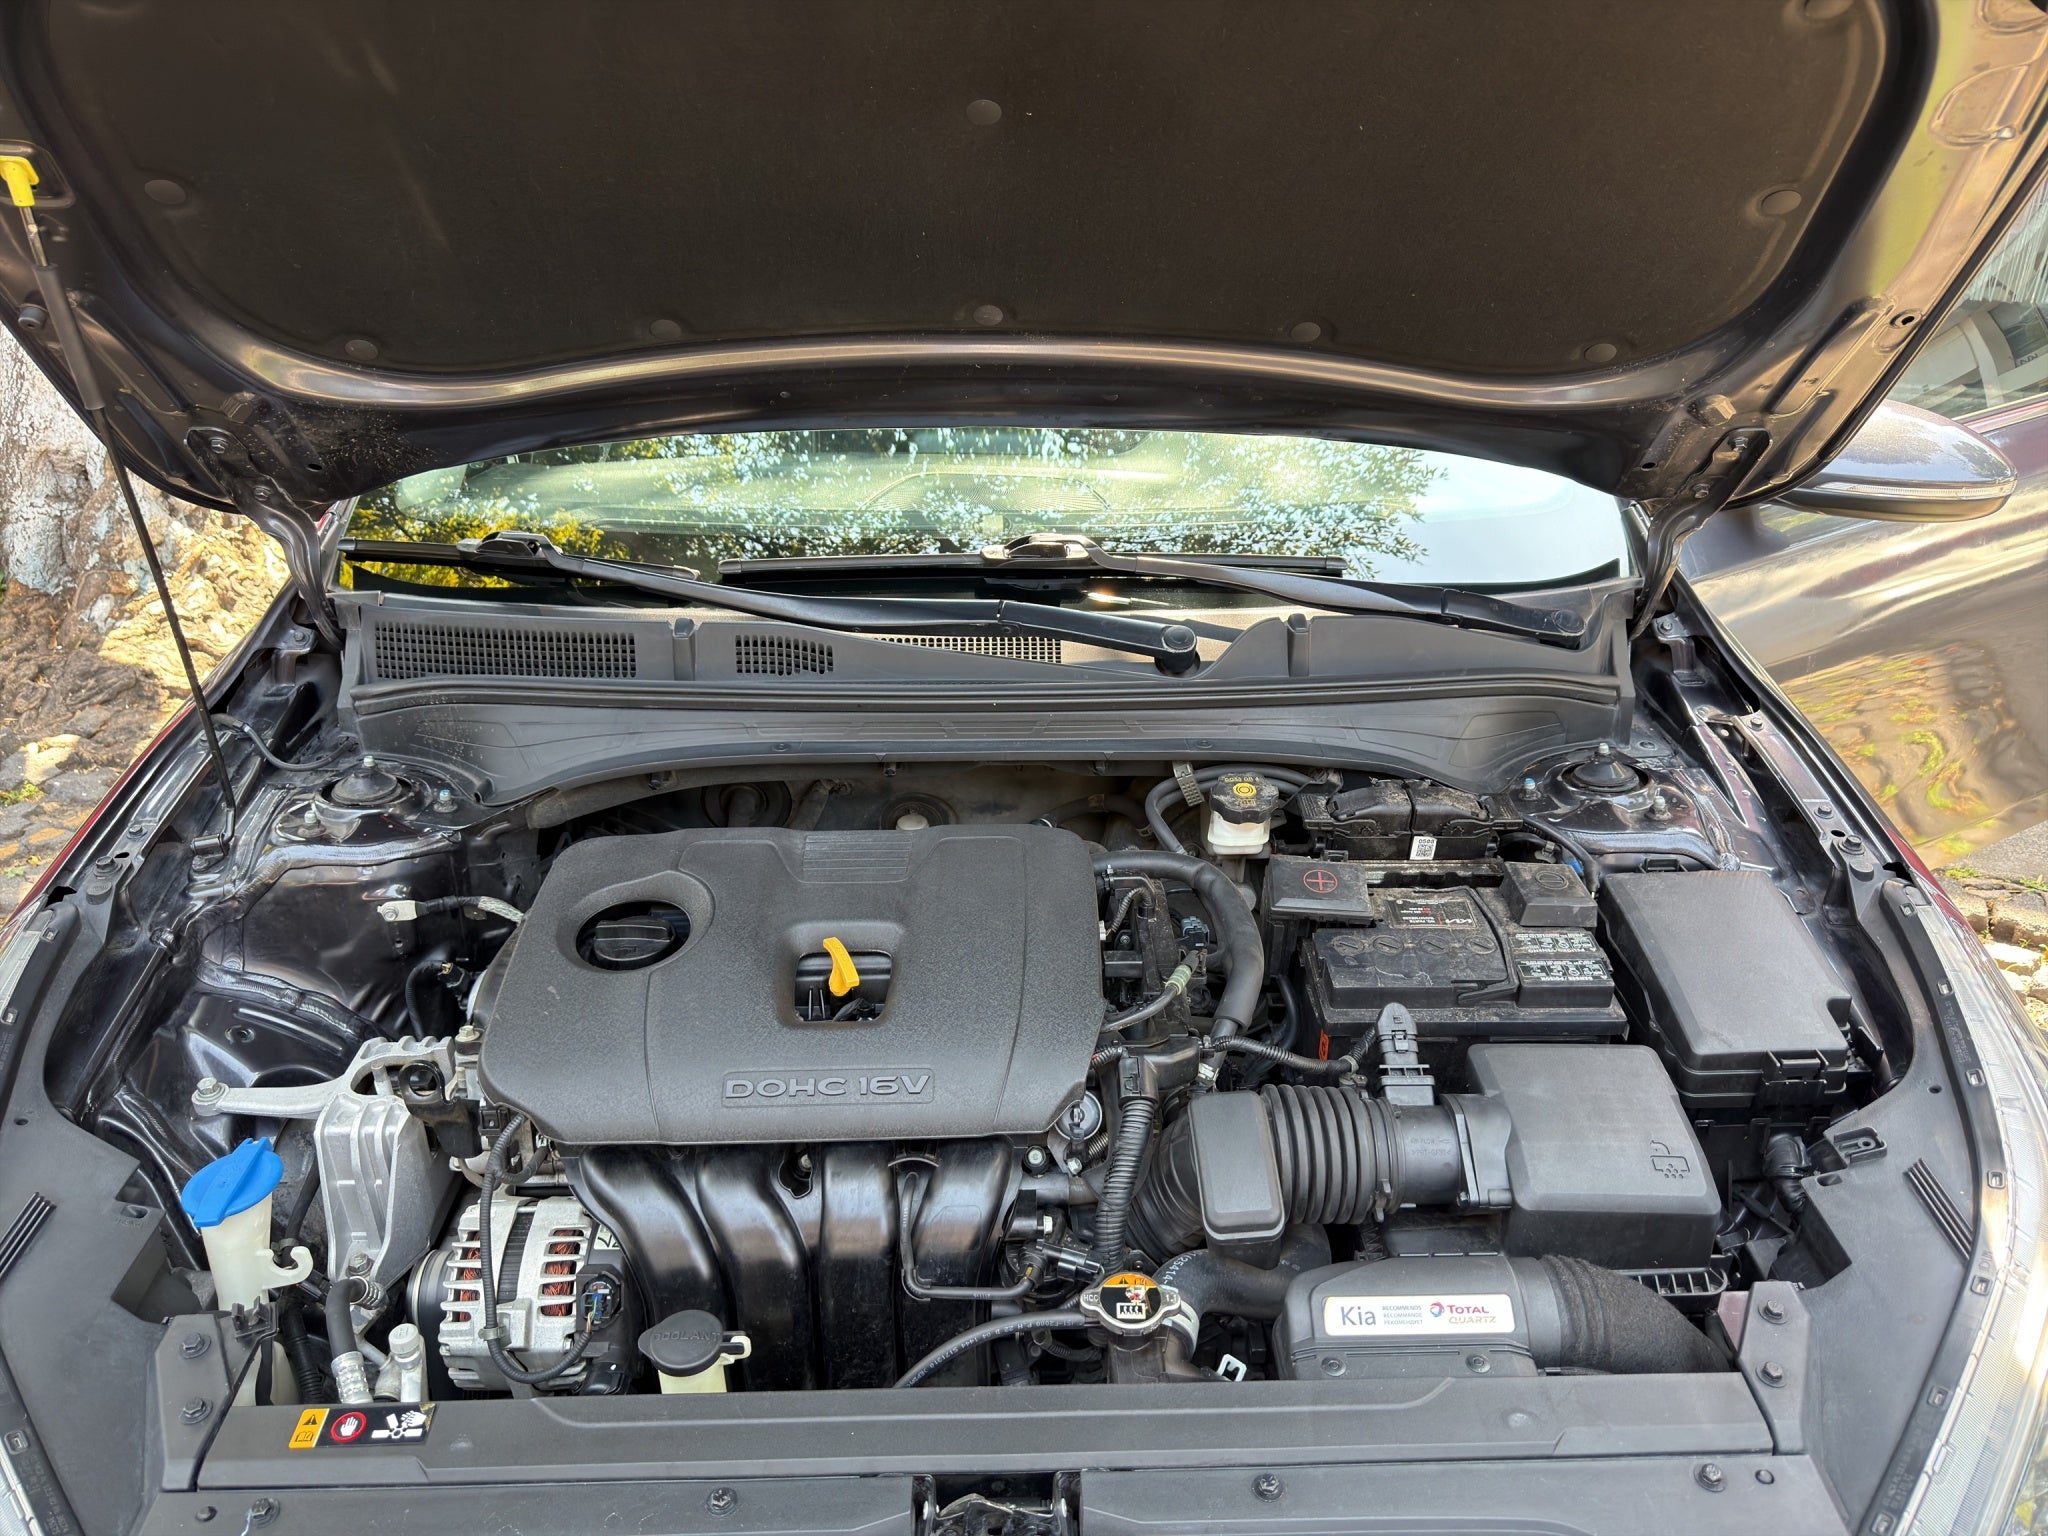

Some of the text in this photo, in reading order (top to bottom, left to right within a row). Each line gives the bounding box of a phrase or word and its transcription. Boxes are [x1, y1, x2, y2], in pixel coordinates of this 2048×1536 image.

[725, 1075, 930, 1099] DOHC 16V
[1083, 1293, 1099, 1302] HCC
[1446, 1304, 1490, 1314] TOTAL
[1340, 1305, 1377, 1326] Kia
[1448, 1316, 1497, 1325] QUARTZ
[654, 1329, 721, 1343] COOLANT
